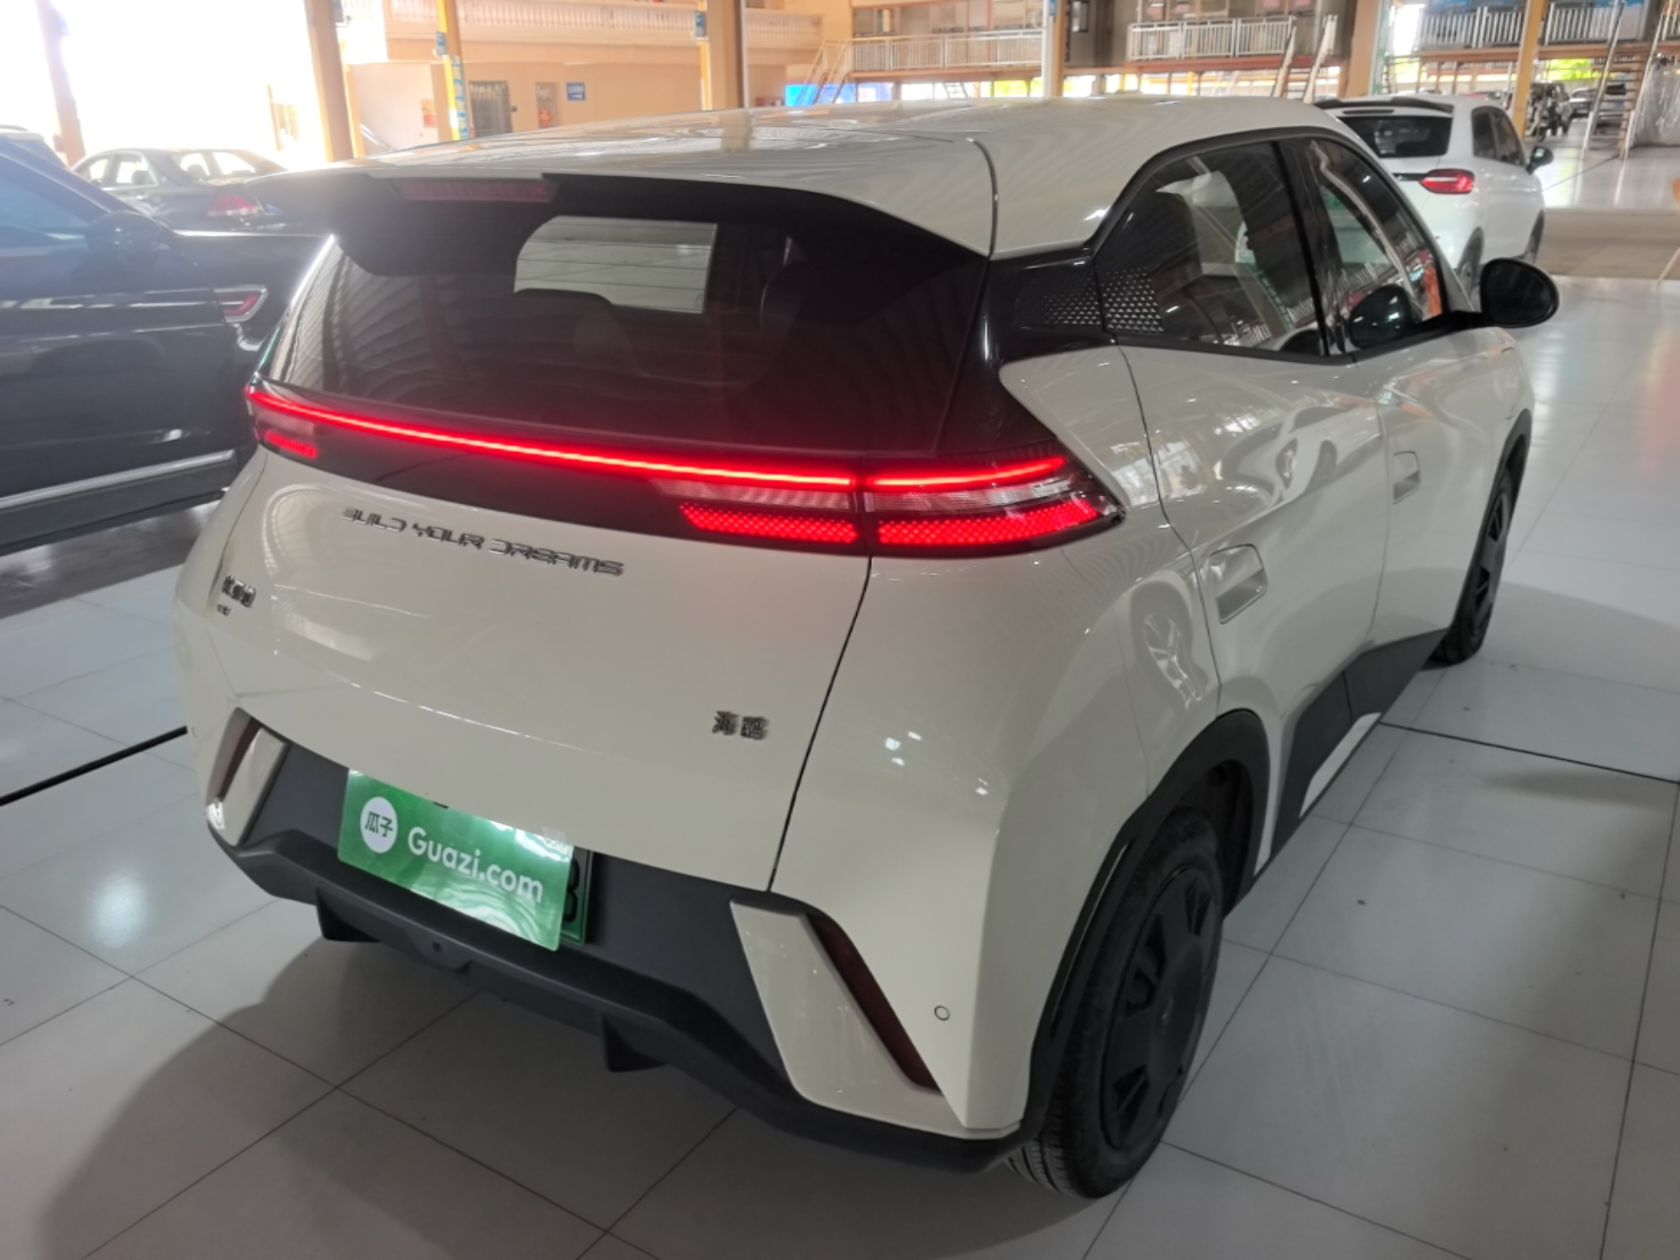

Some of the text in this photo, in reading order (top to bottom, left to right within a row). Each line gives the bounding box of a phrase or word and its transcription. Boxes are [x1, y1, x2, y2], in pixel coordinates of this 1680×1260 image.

[412, 523, 485, 550] YOUR
[489, 538, 624, 577] DREAMS
[364, 810, 394, 838] 瓜子
[407, 826, 544, 904] Guazi.com
